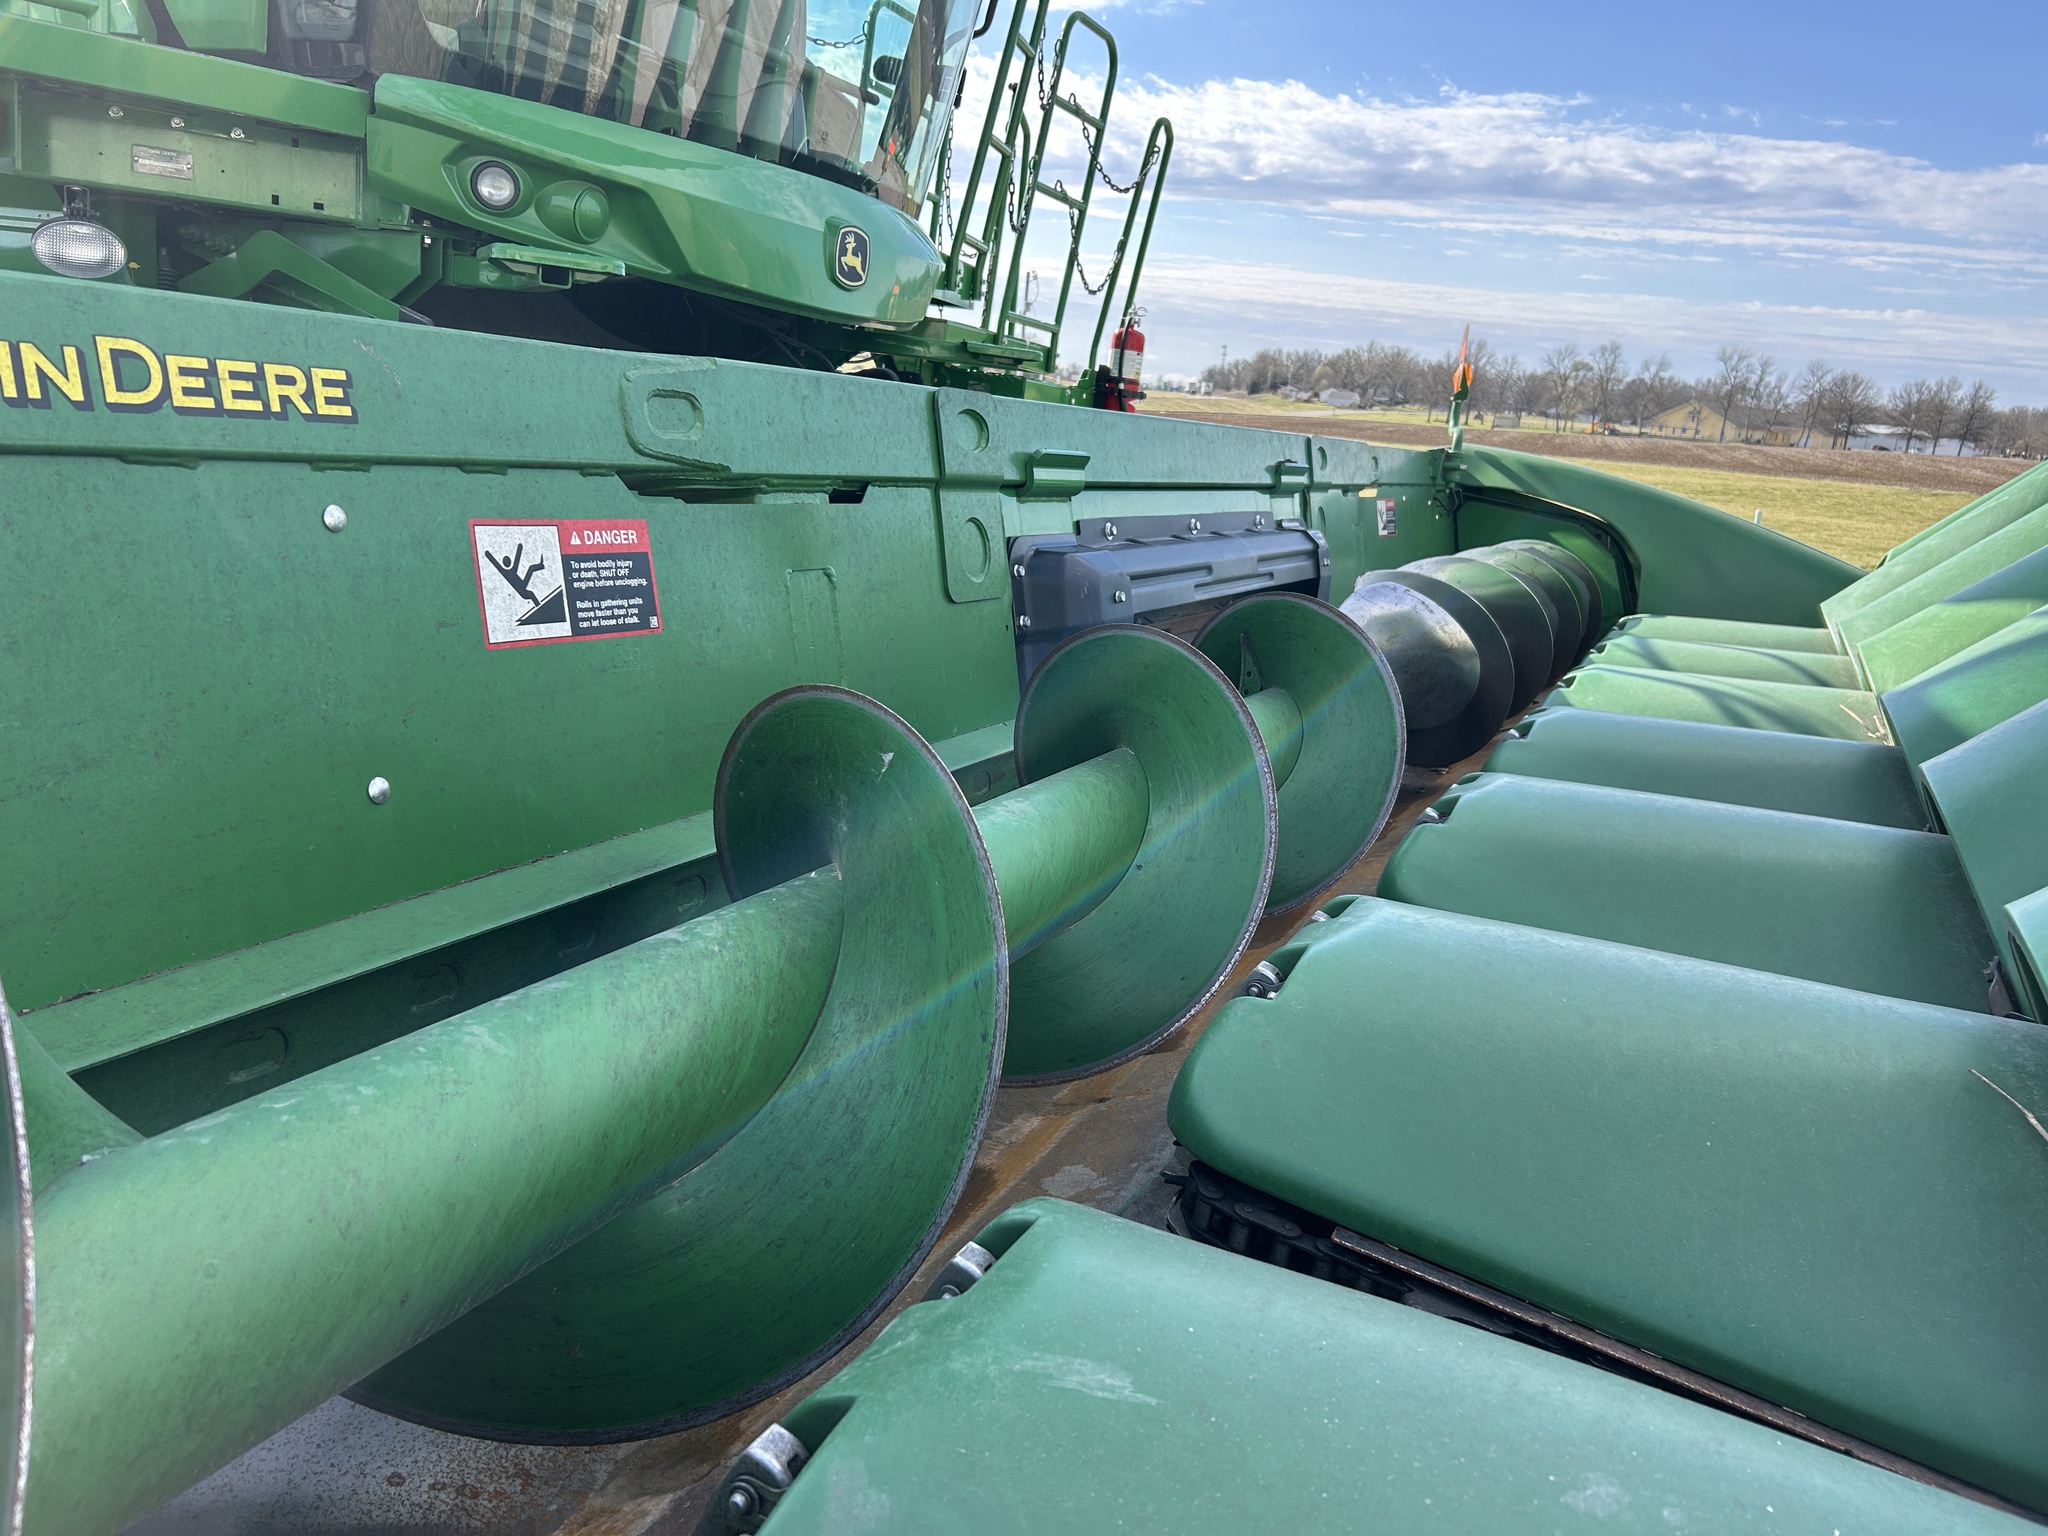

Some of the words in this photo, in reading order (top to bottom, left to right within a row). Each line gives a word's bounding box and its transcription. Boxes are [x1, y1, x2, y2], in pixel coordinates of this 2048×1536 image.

[94, 335, 358, 424] DEERE
[584, 529, 638, 545] DANGER
[570, 561, 579, 569] To
[580, 560, 597, 568] avoid
[597, 560, 615, 568] bodily
[616, 559, 633, 569] injury
[599, 569, 616, 577] SHUT
[617, 568, 630, 576] OFF
[573, 580, 594, 589] engine
[595, 579, 614, 587] before
[615, 577, 648, 587] unclogging.
[600, 599, 628, 608] gathering
[628, 597, 643, 605] units
[627, 607, 639, 616] you
[624, 616, 640, 624] stalk.
